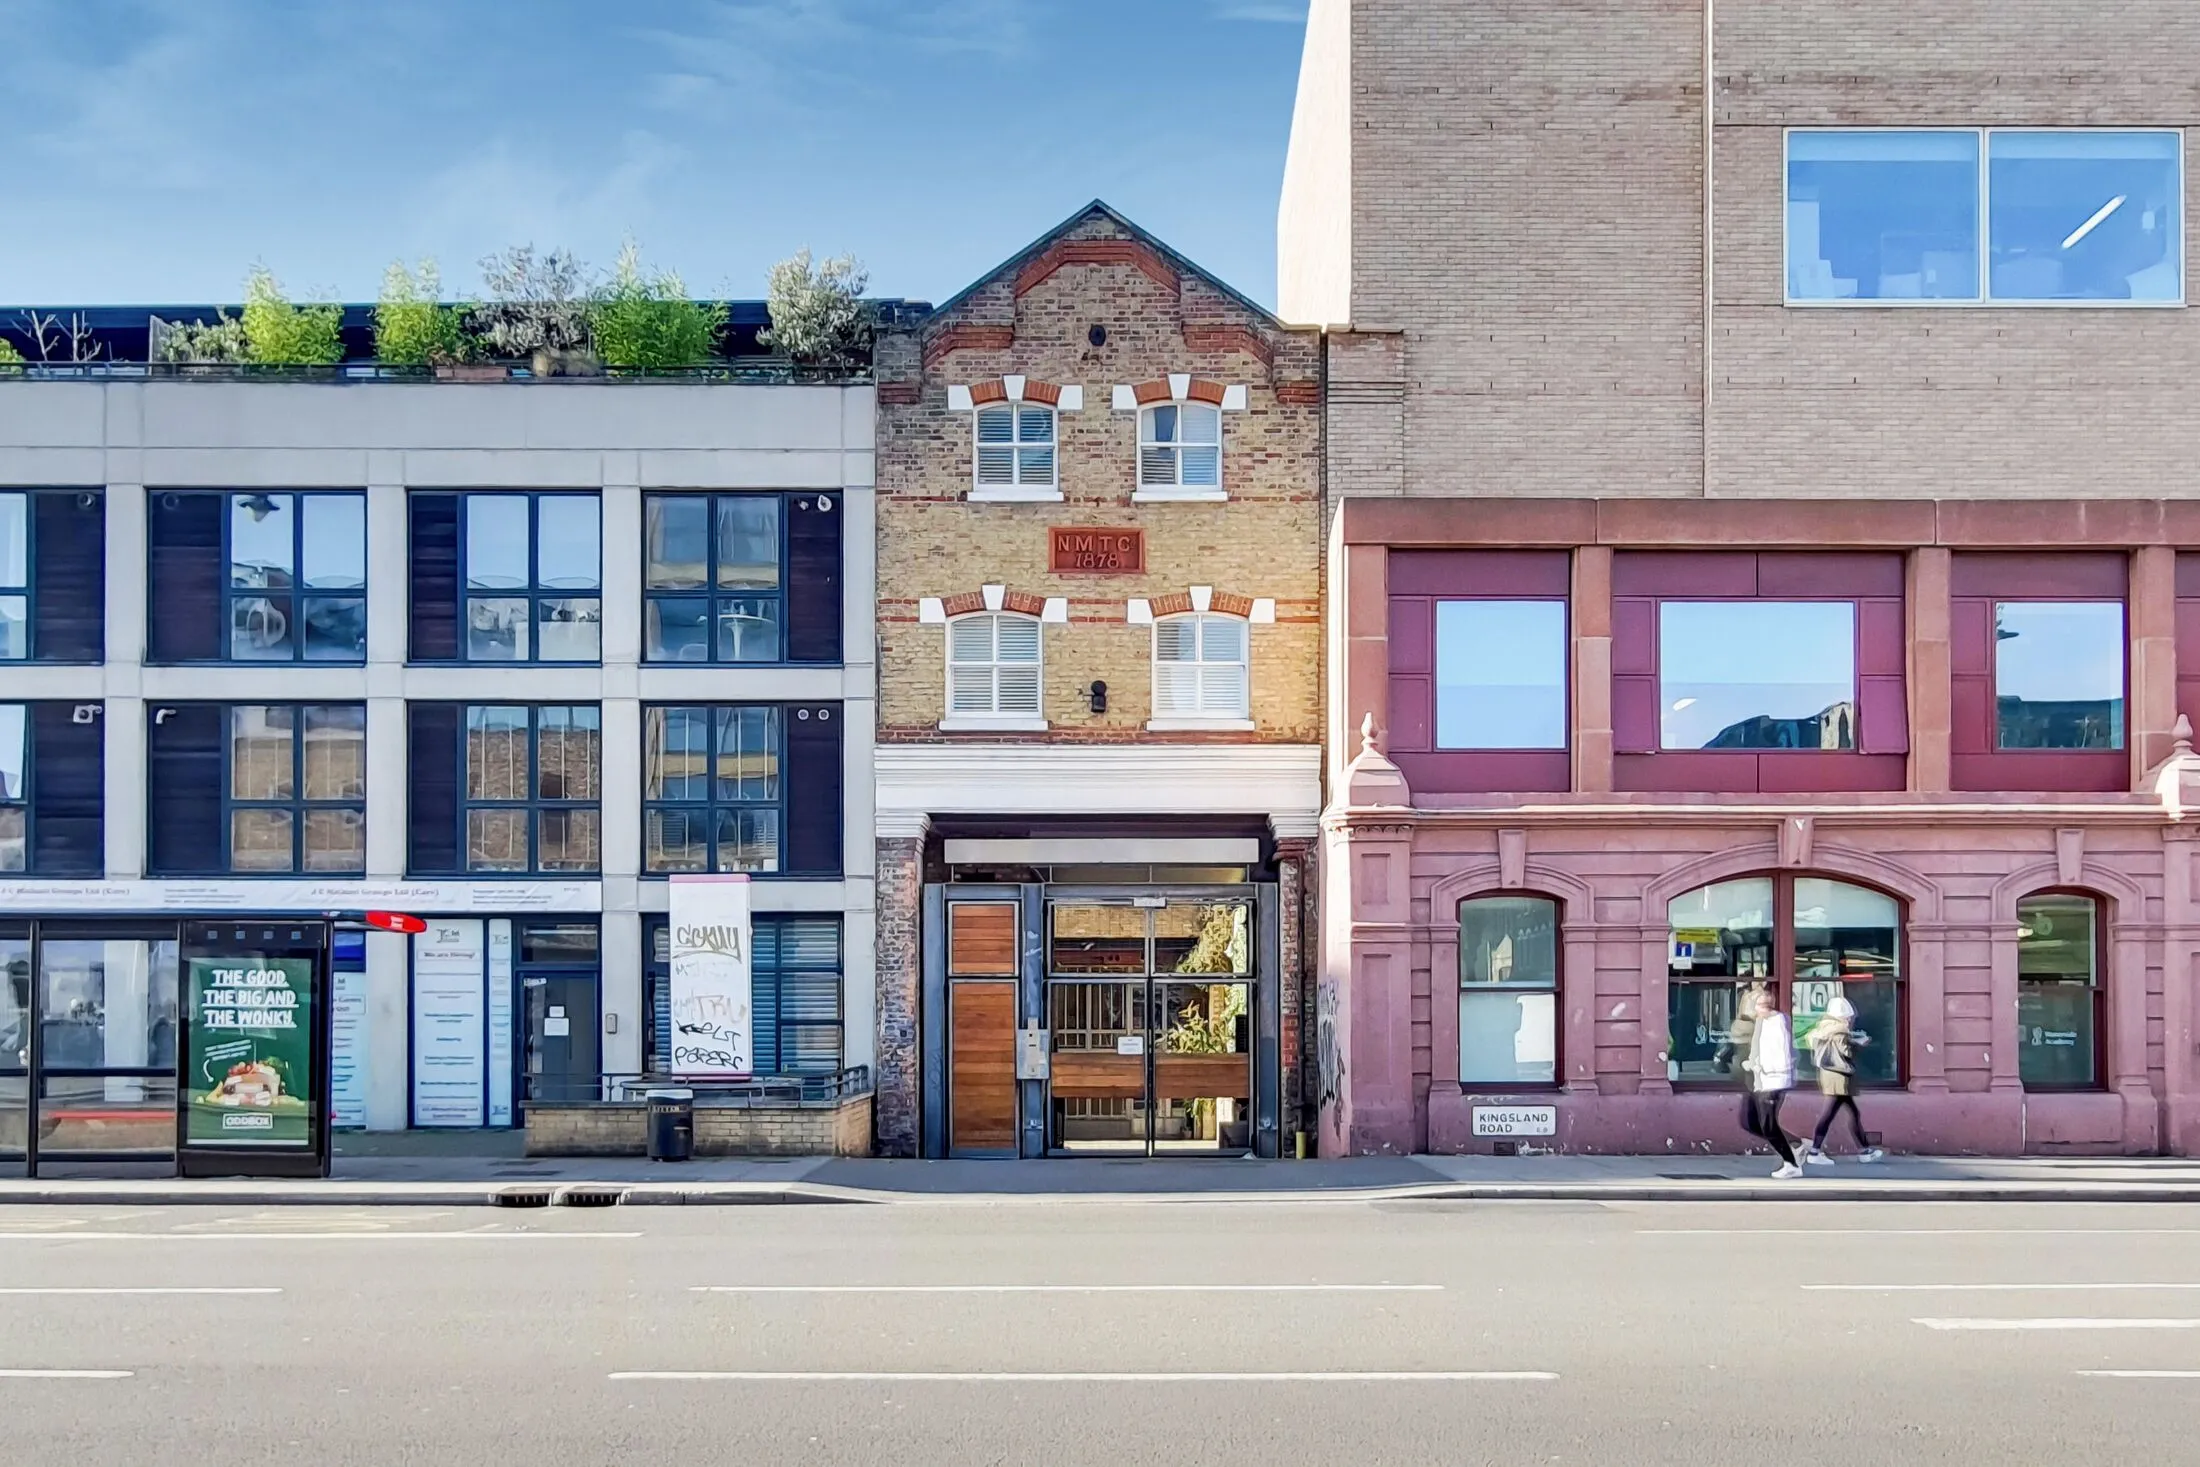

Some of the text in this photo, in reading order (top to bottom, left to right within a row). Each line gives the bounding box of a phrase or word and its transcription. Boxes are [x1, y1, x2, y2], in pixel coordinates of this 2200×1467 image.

[1075, 552, 1119, 569] 1878
[212, 970, 243, 985] THE
[203, 990, 297, 1005] THE BIG AND
[204, 1010, 236, 1025] THE
[1479, 1113, 1548, 1122] KINGSLAND
[1479, 1124, 1513, 1133] ROAD
